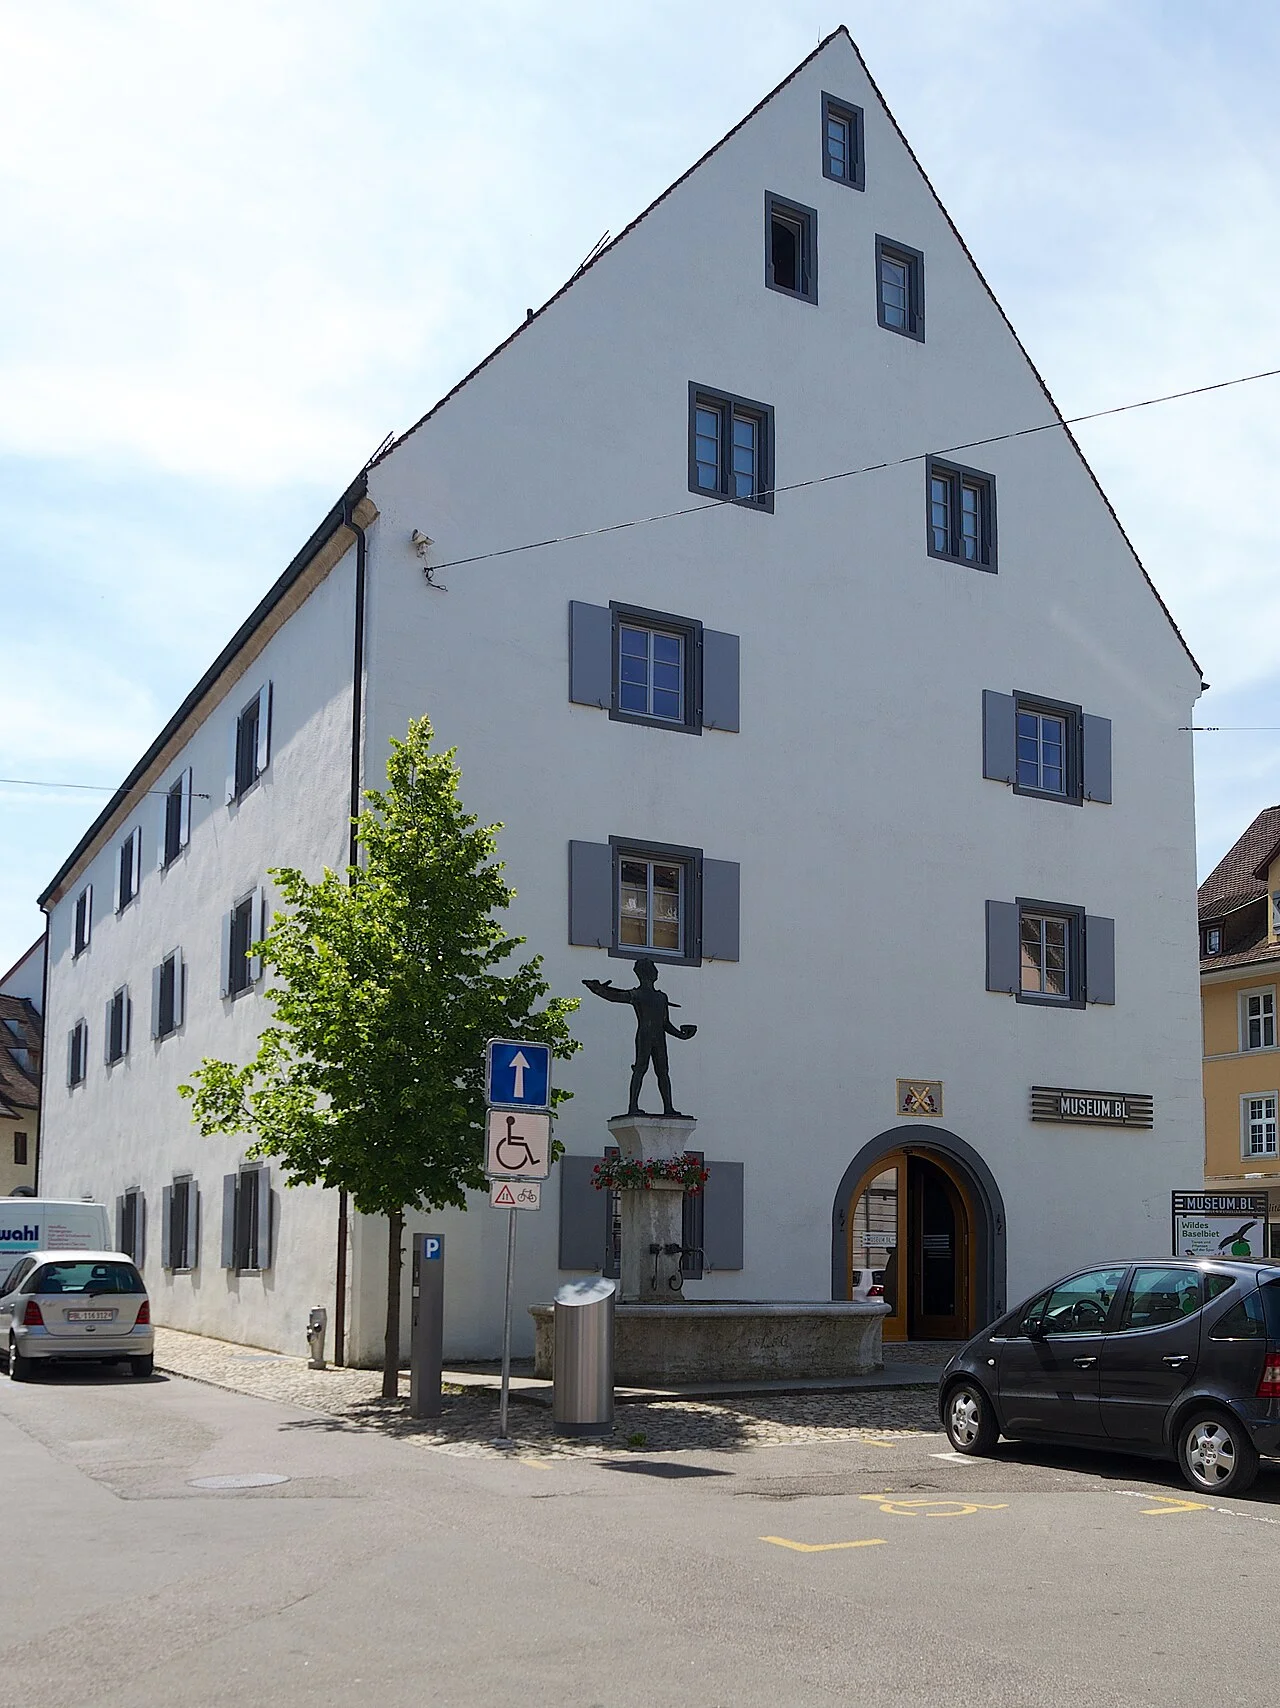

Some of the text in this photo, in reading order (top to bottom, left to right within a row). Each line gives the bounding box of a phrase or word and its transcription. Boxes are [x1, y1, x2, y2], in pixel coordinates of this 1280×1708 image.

[1061, 1097, 1129, 1119] MUSEUM.BL
[1186, 1197, 1254, 1210] MUSEUM.BL
[1181, 1221, 1209, 1229] Wildes
[1182, 1230, 1220, 1238] Baselbiet
[426, 1239, 439, 1258] P
